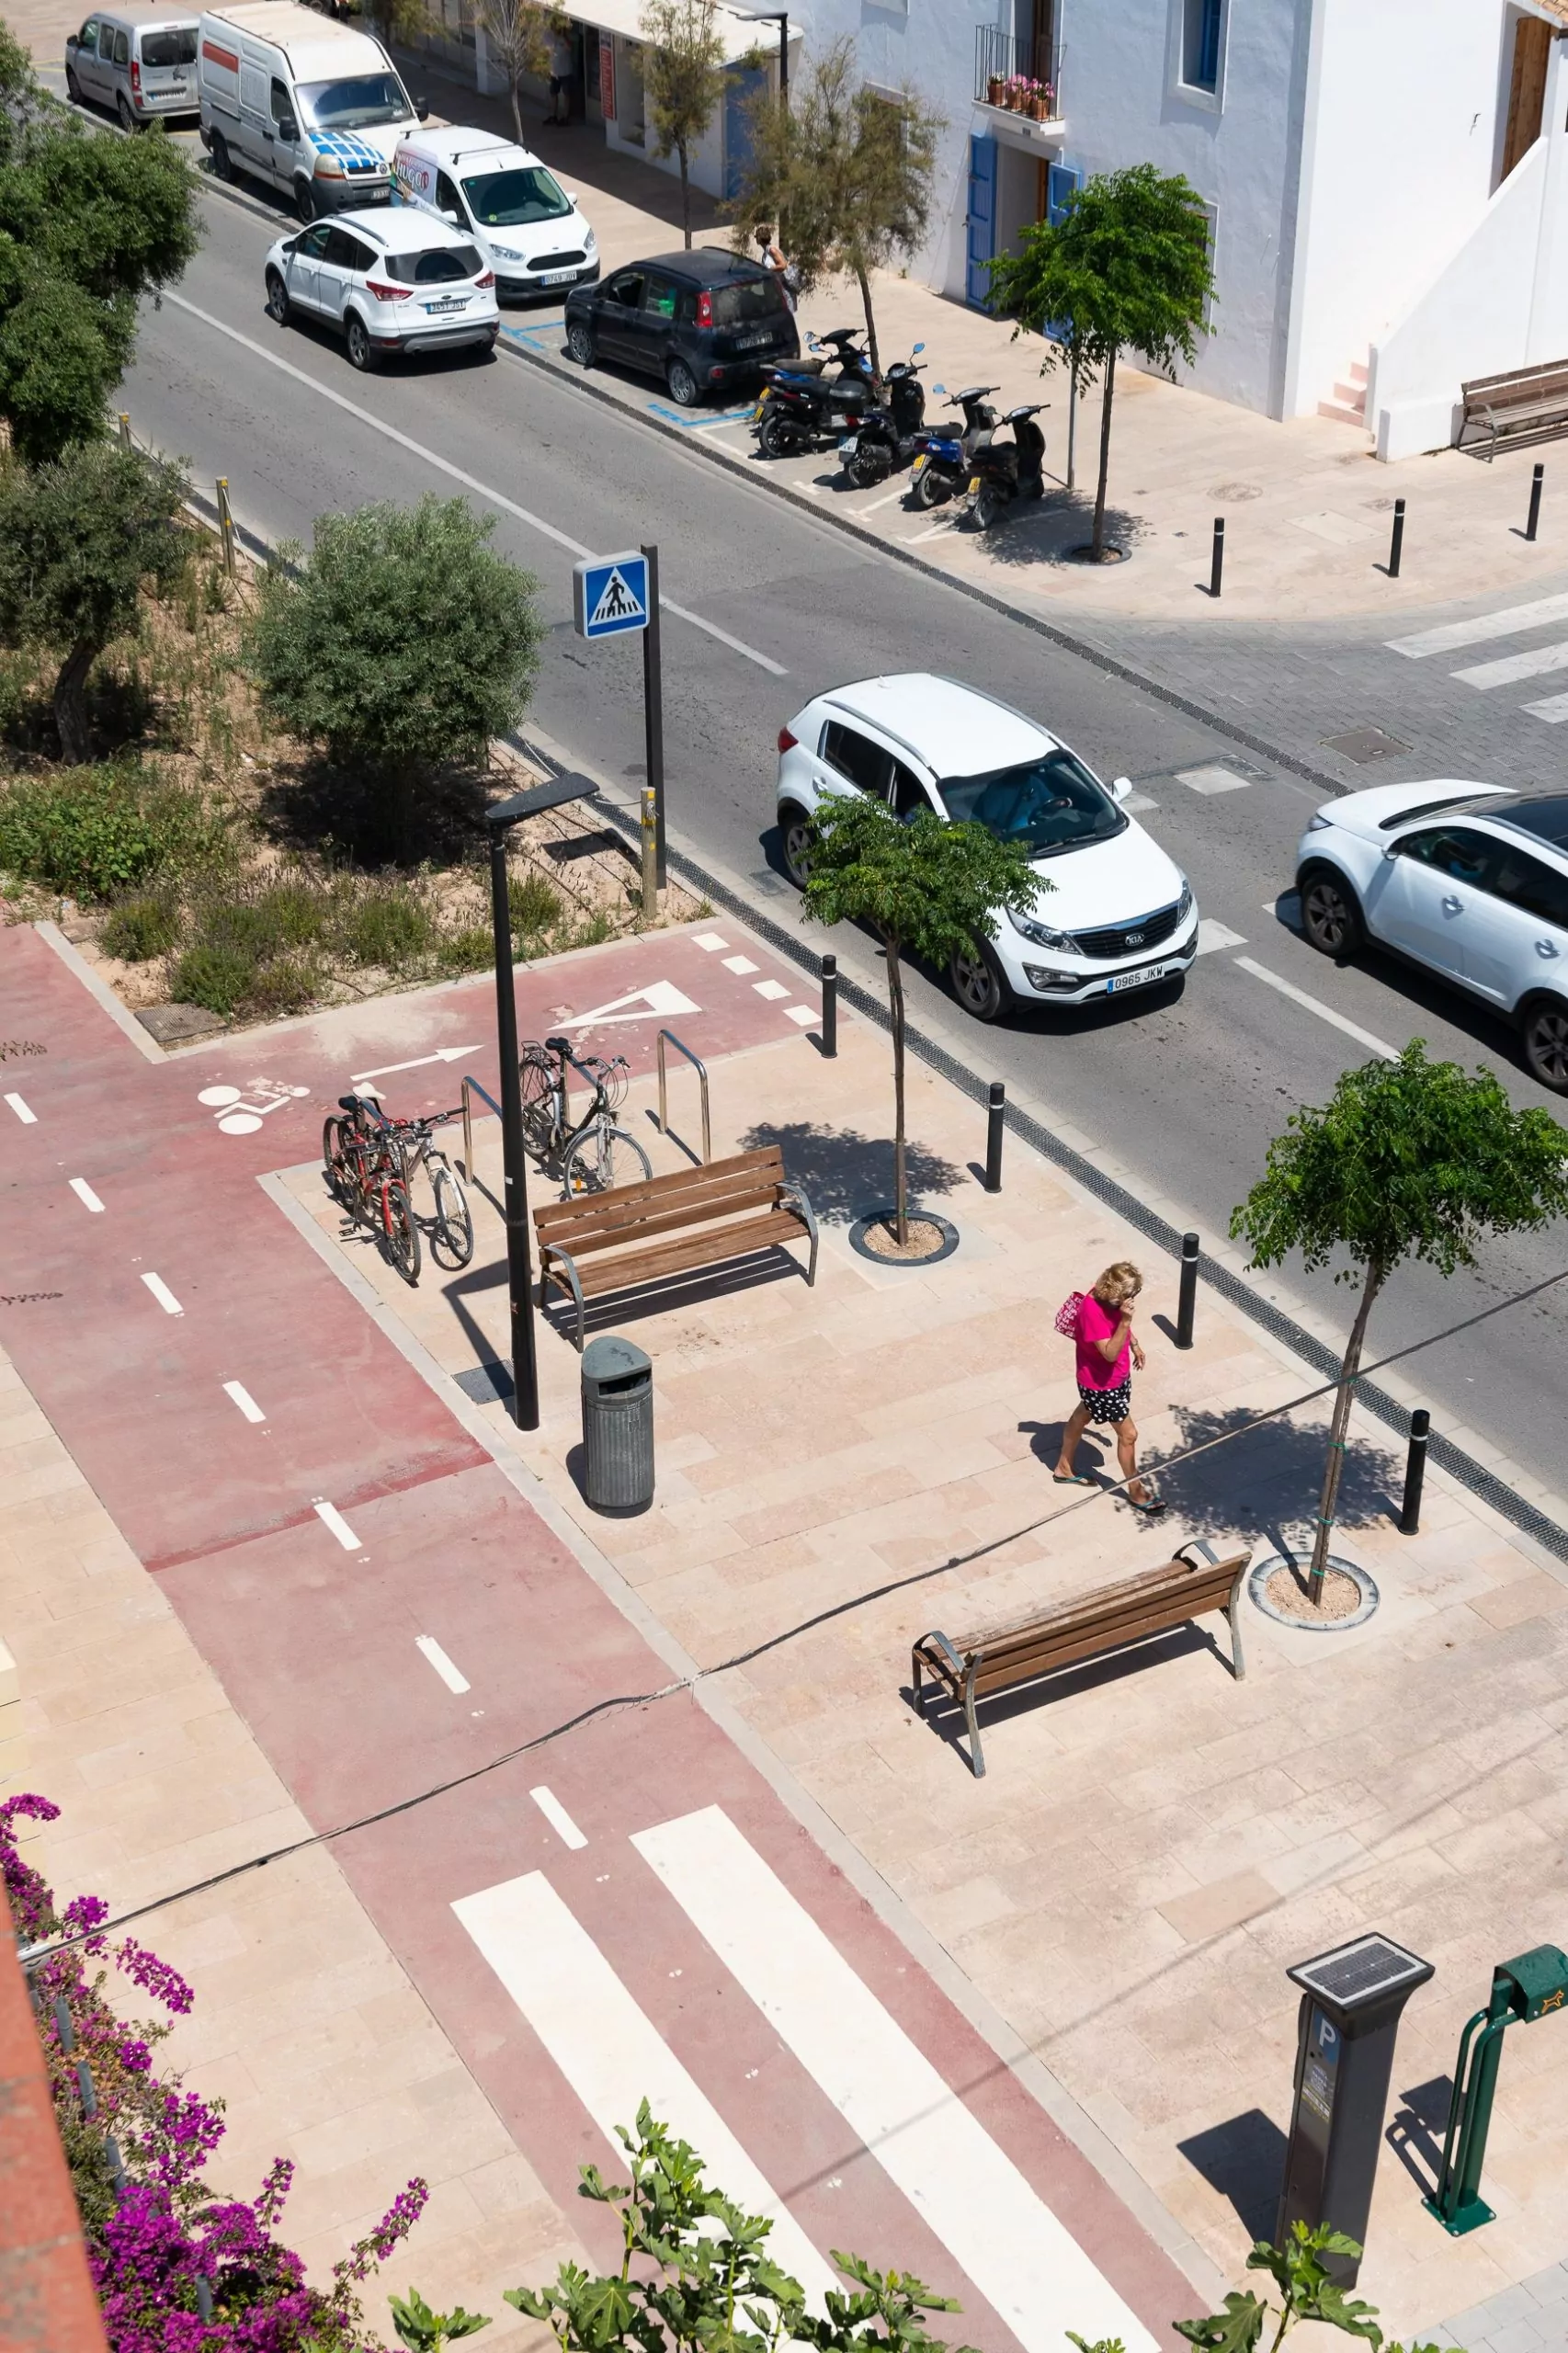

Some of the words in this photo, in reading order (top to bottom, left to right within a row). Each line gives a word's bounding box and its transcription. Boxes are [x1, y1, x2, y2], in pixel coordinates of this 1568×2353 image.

[1115, 973, 1141, 989] 0965
[1143, 966, 1163, 981] JKW
[1319, 2018, 1335, 2047] P
